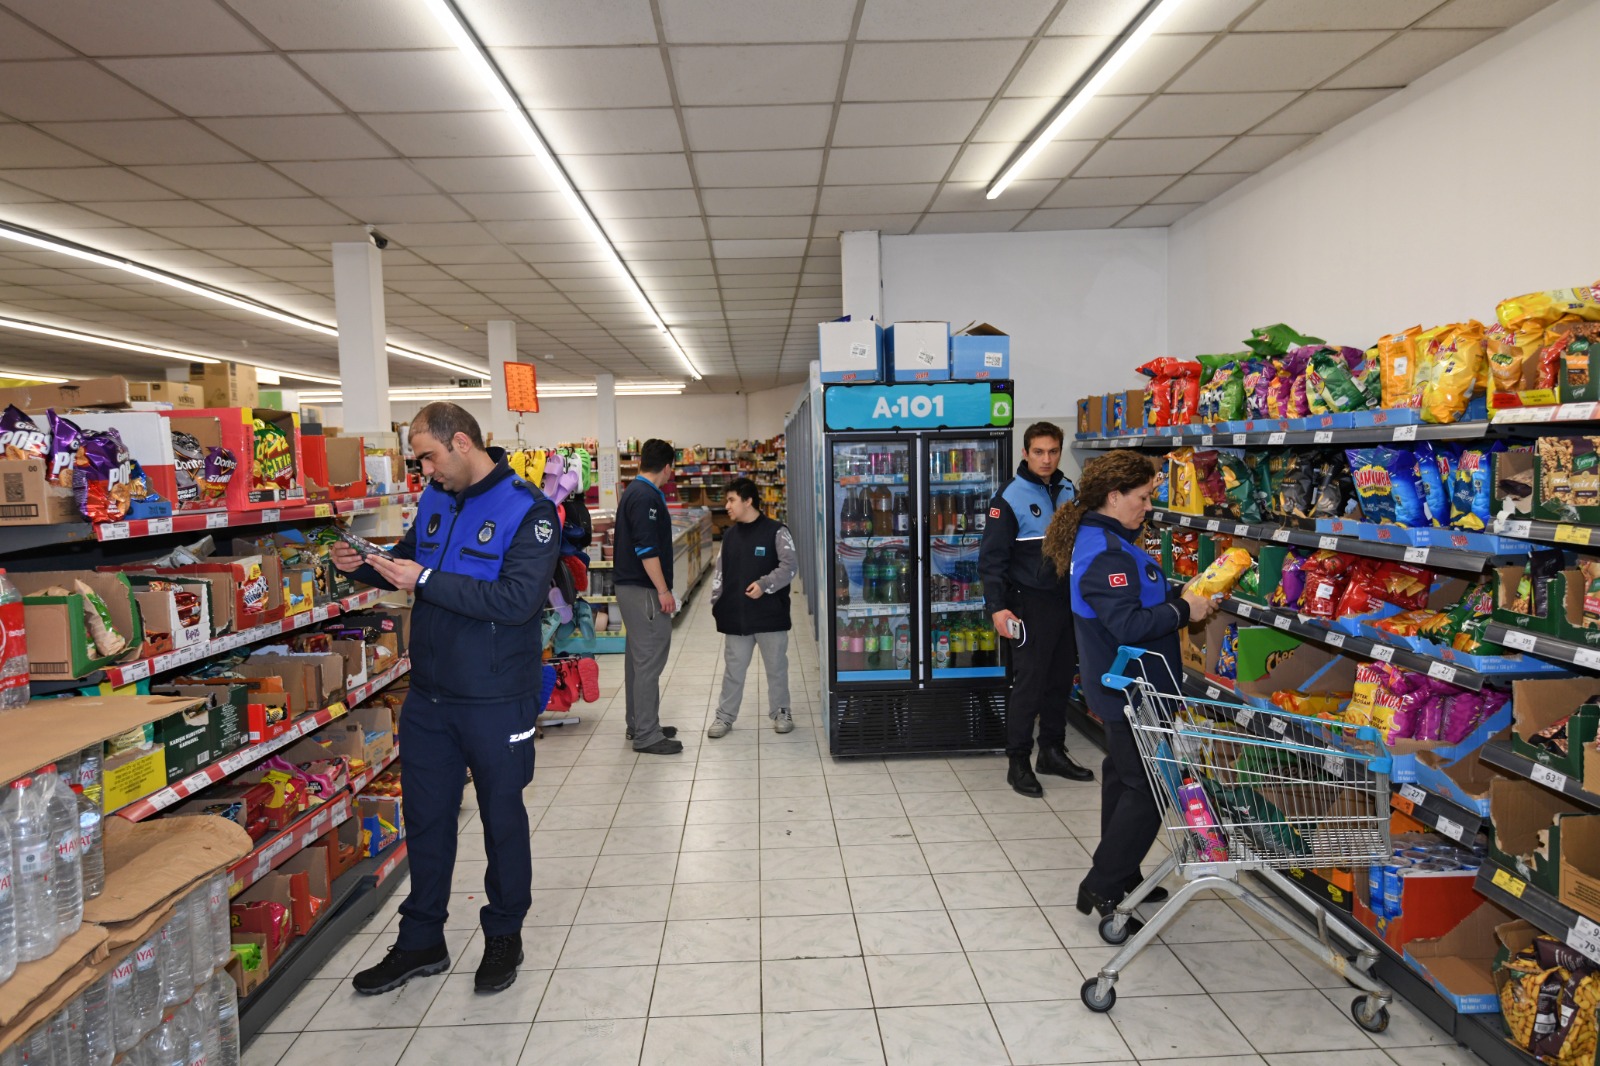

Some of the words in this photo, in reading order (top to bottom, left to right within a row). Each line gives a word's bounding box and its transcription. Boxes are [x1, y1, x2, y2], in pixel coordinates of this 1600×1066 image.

[1545, 772, 1556, 783] 63
[1411, 789, 1420, 798] 27
[1584, 941, 1596, 953] 79
